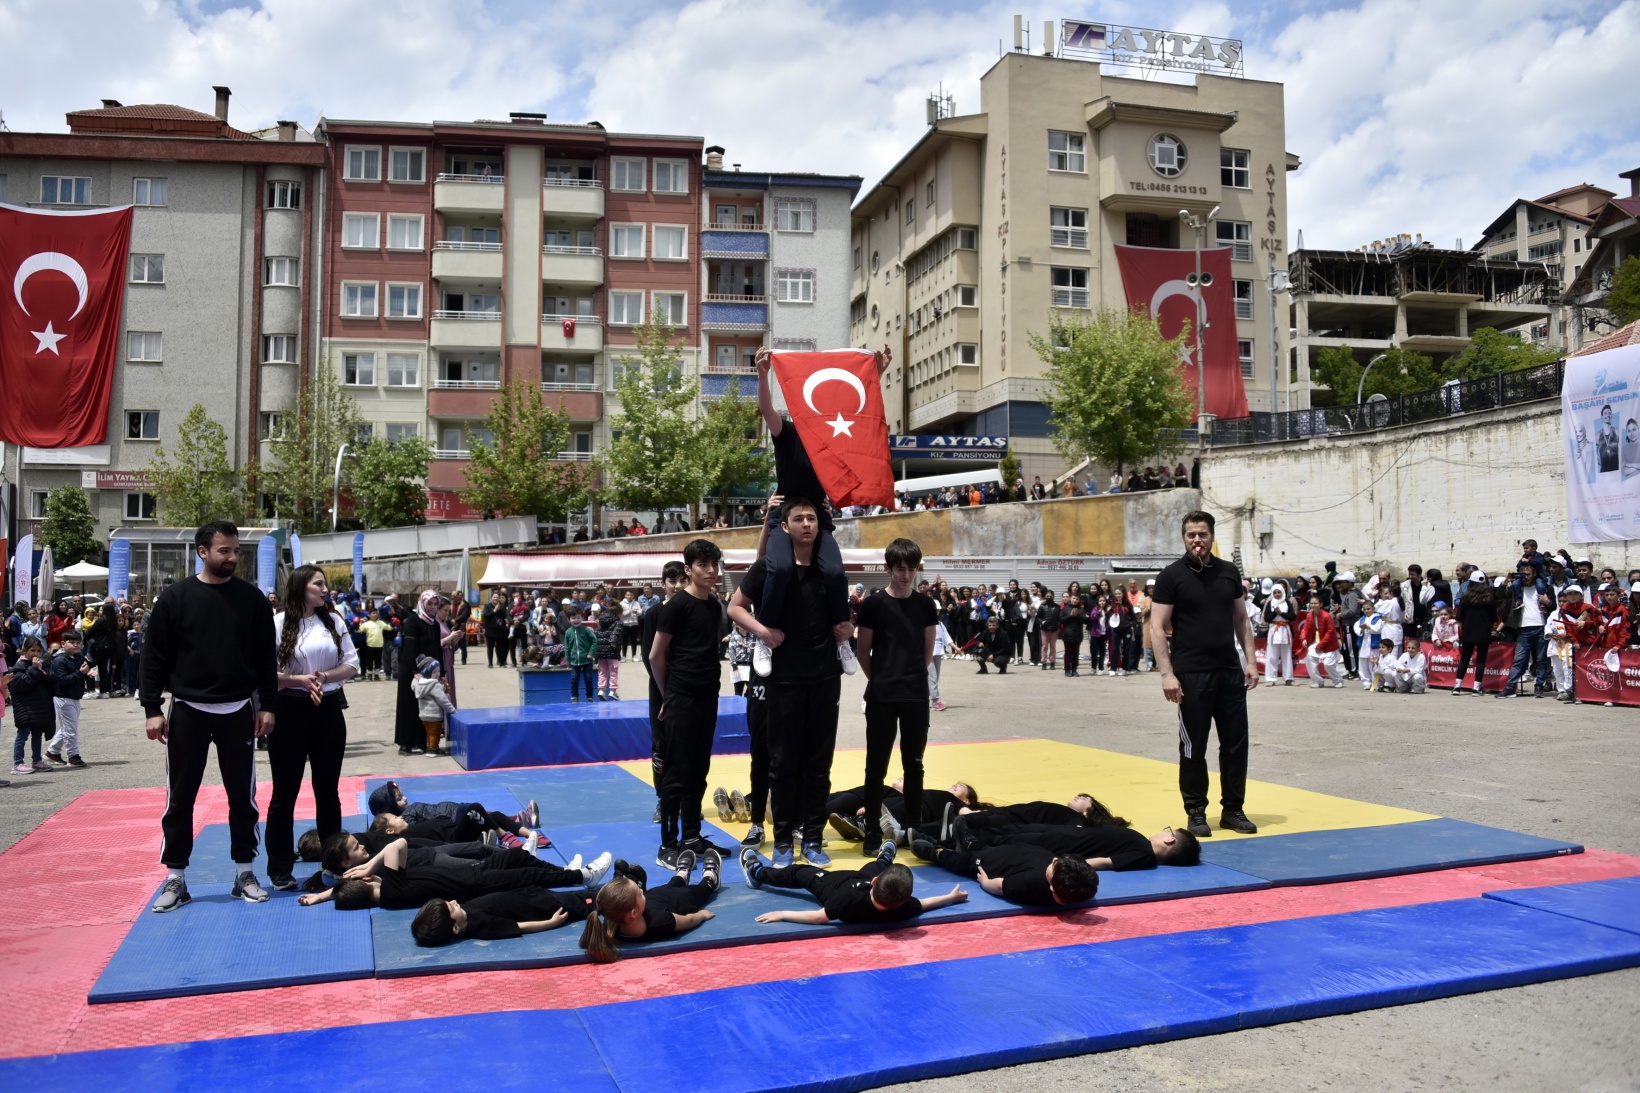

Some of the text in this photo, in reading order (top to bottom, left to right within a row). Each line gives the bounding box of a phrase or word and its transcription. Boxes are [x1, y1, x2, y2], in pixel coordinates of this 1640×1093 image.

[1108, 28, 1240, 68] AYTAŞ
[1173, 185, 1187, 194] 213
[1188, 186, 1197, 194] 13
[1199, 187, 1207, 195] 13
[1265, 163, 1276, 236] AYTAŞ
[1261, 238, 1282, 252] KIZ
[929, 436, 1007, 448] AYTAŞ
[953, 451, 1001, 459] PANSİYONU
[97, 471, 114, 481] İLİM
